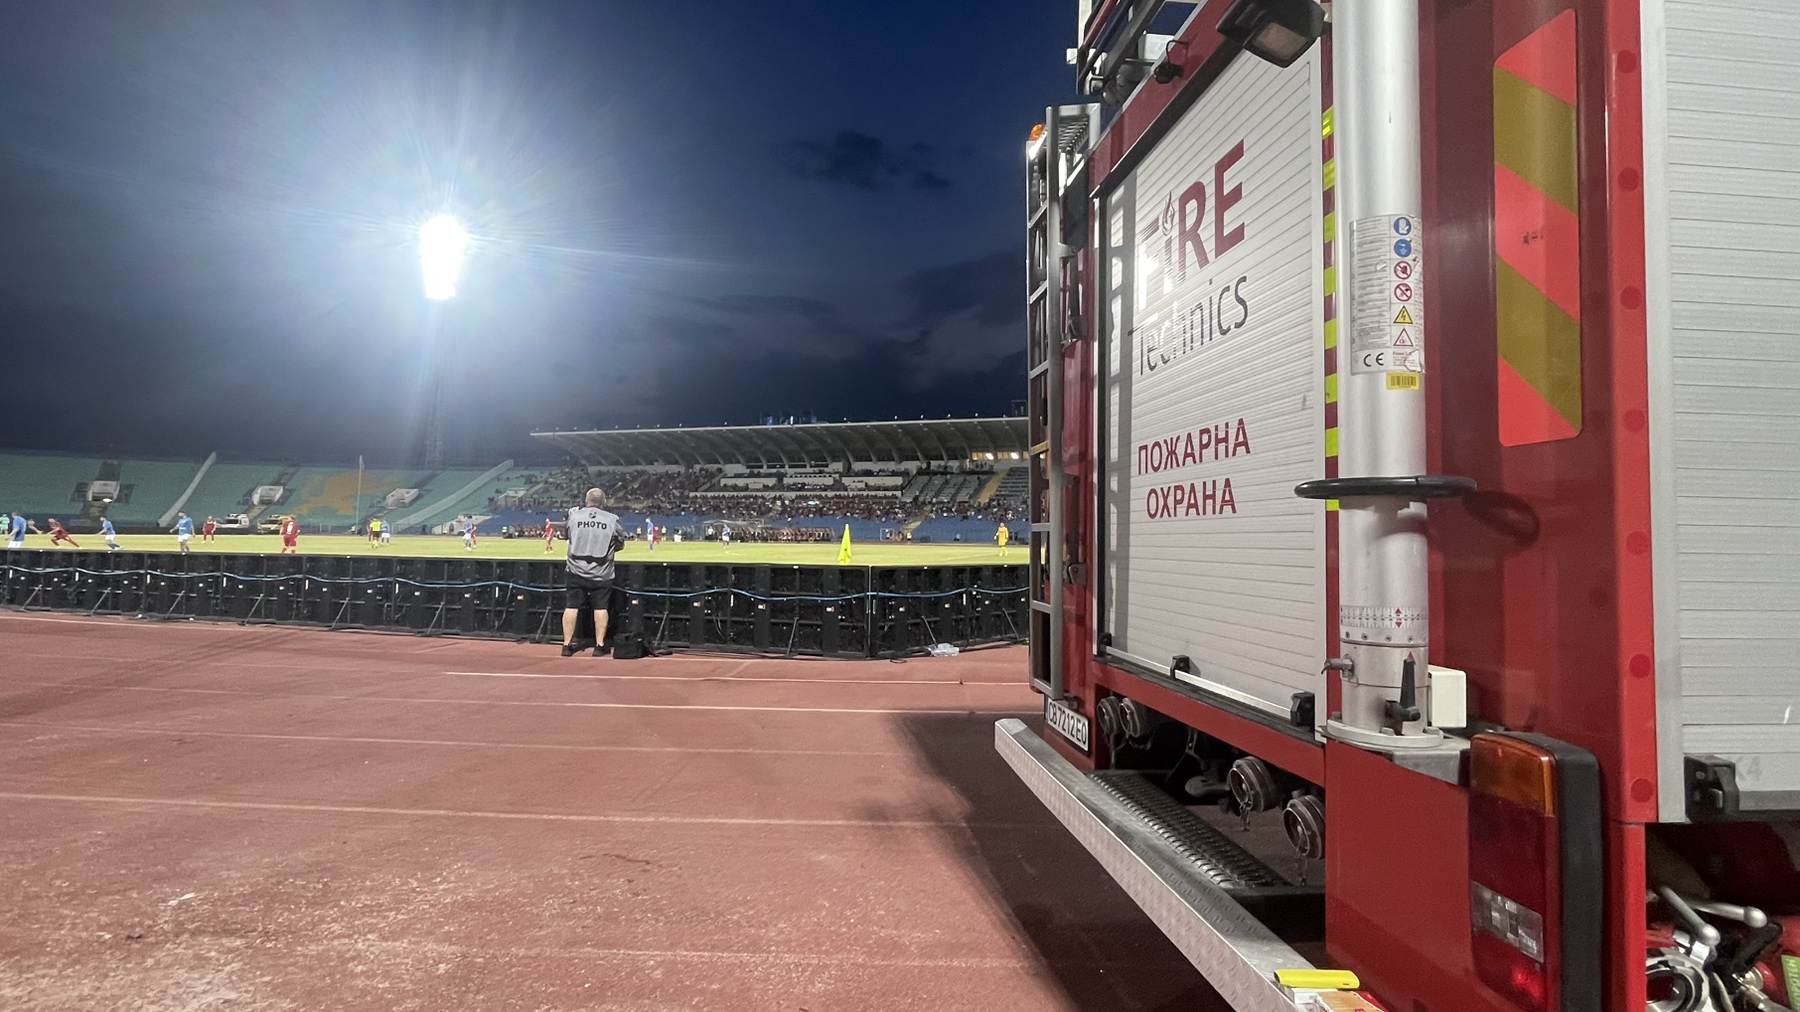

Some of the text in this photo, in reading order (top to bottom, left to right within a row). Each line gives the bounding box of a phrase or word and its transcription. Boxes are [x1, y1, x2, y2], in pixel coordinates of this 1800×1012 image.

[1138, 417, 1251, 475] ПОЖАРНА
[1146, 477, 1237, 519] ОХРАНА
[577, 520, 607, 530] PHOTO
